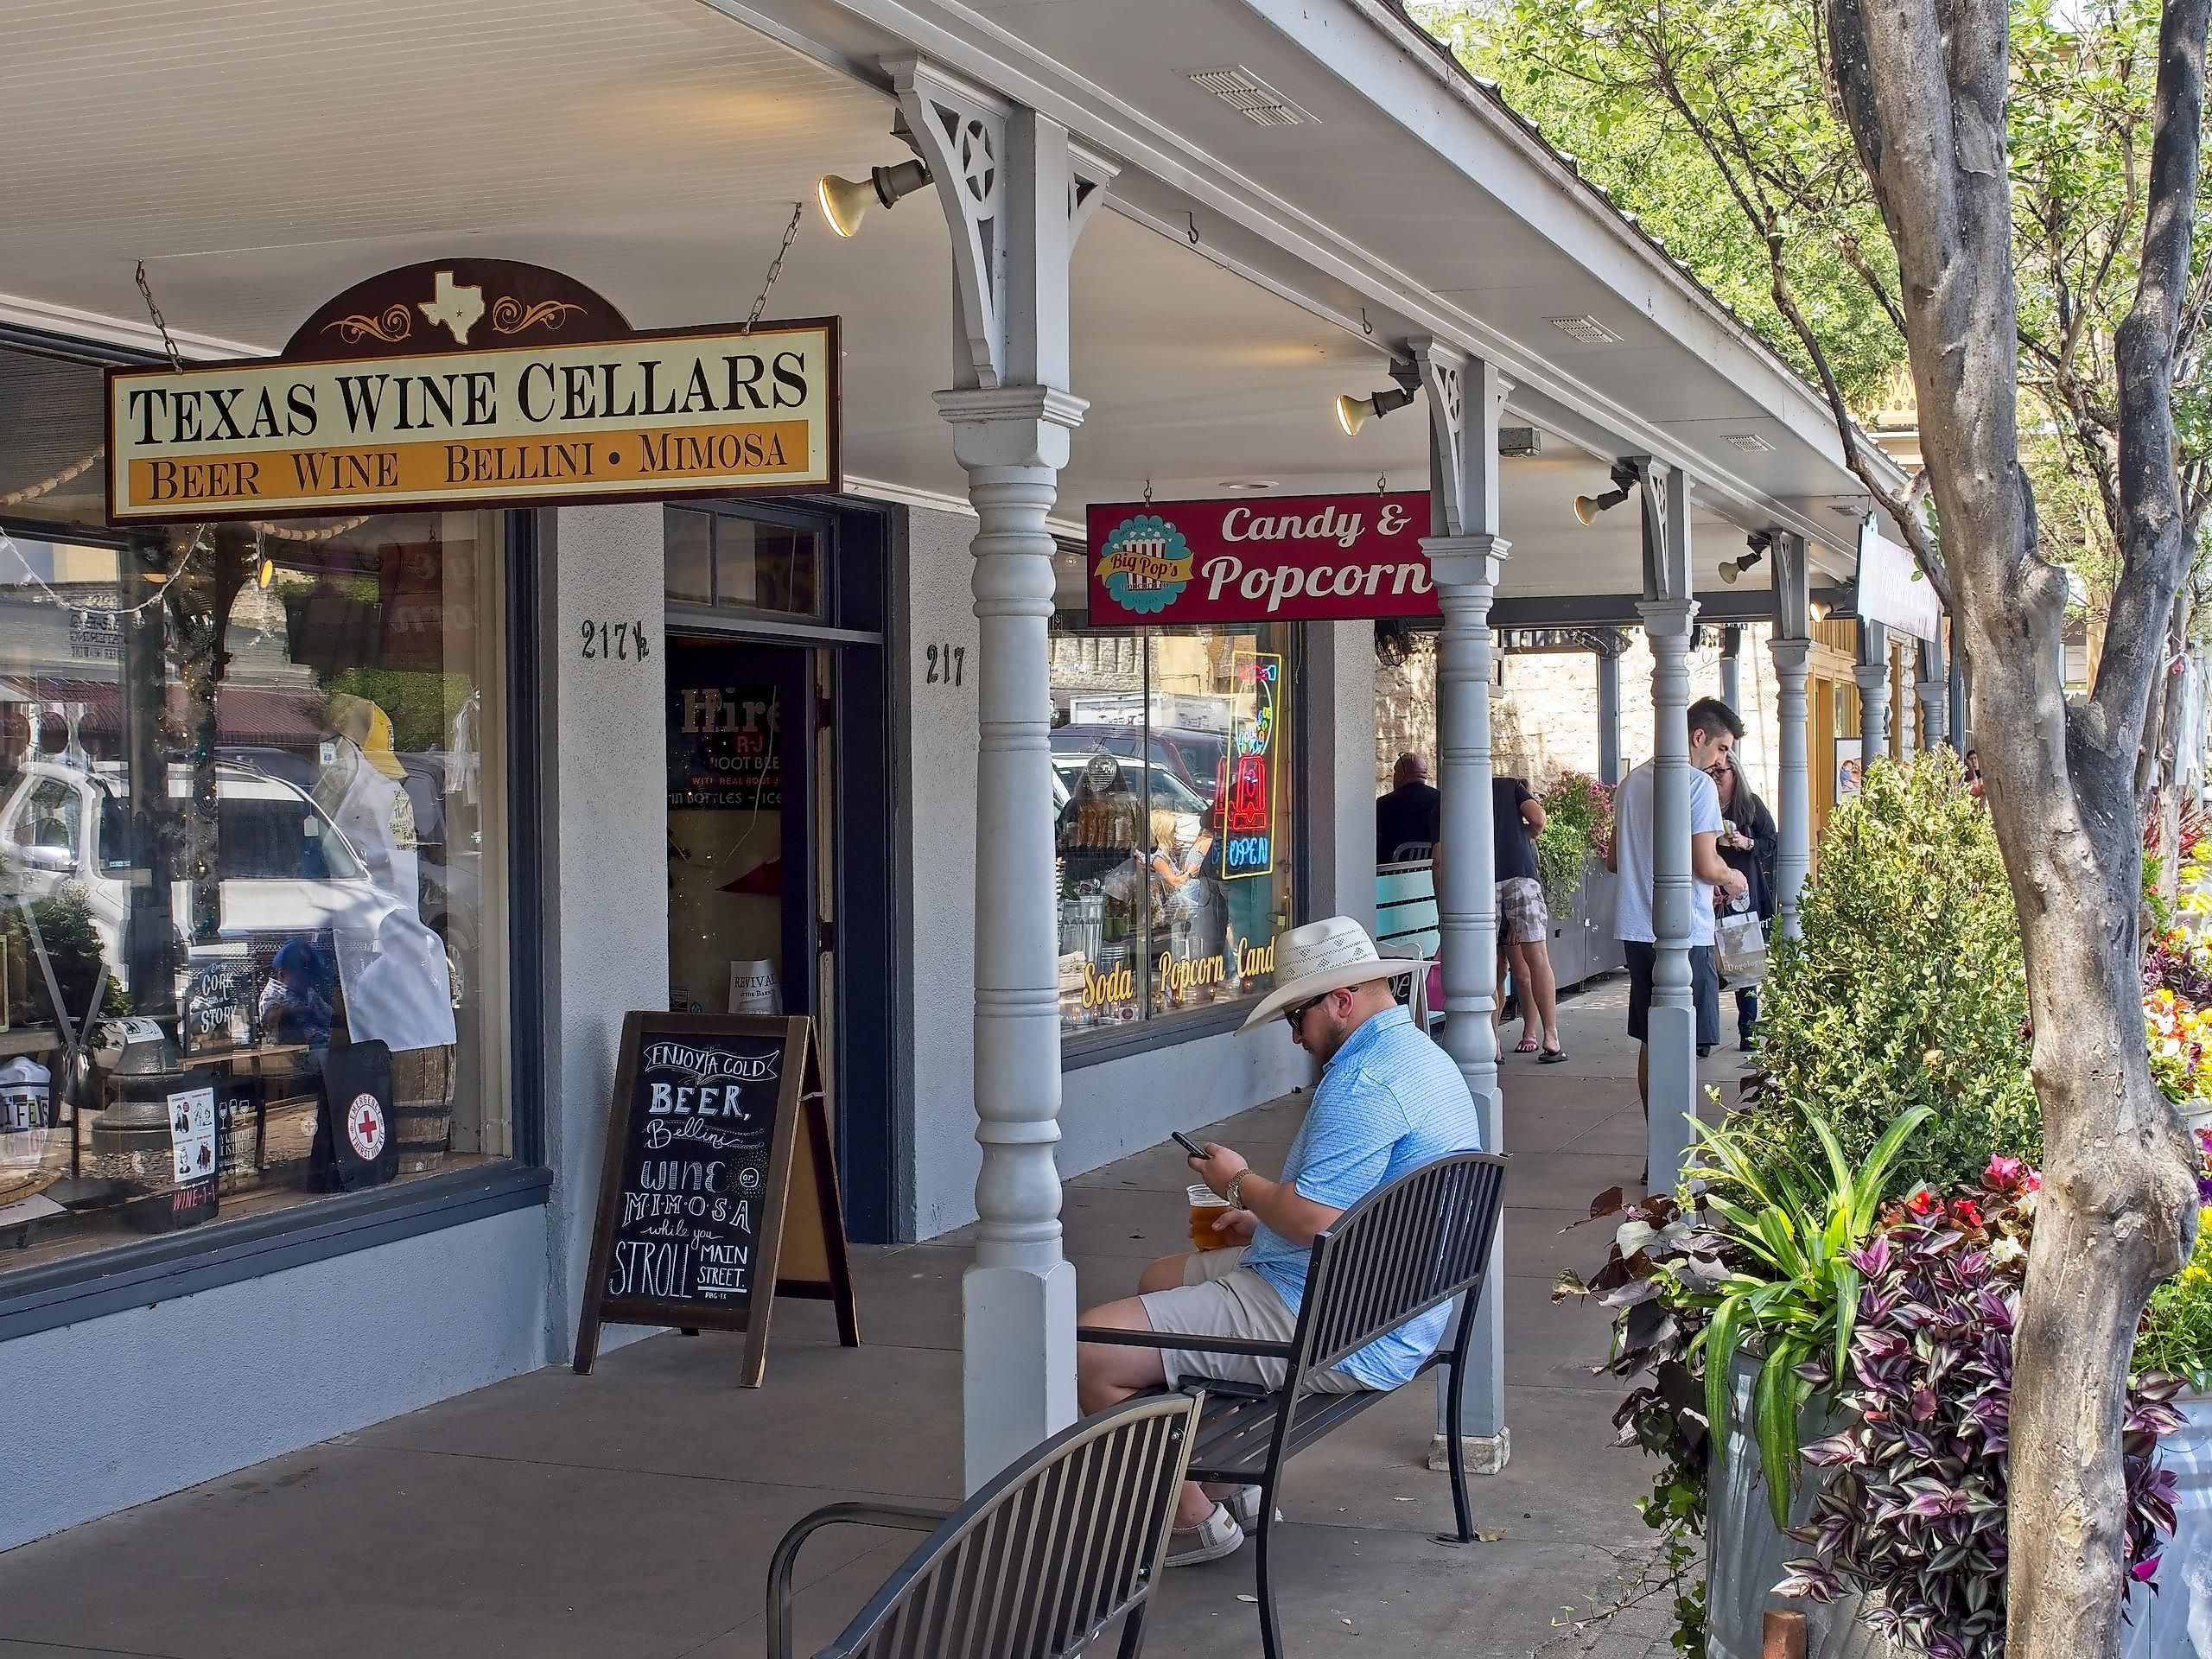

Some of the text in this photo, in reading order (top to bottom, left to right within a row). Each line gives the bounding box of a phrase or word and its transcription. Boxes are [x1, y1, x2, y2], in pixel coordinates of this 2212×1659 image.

[129, 351, 810, 446] TEXAS WINE CELLARS
[149, 430, 788, 501] BEER WINE BELLINI MIMOSA
[1221, 504, 1412, 548] Candy &
[1110, 553, 1179, 579] Big Pop's
[1201, 555, 1433, 612] Popcorn
[926, 643, 965, 687] 217
[736, 735, 764, 753] R-J
[1229, 836, 1268, 866] OPEN
[202, 973, 234, 1001] CORK
[1081, 960, 1134, 1009] Soda
[1159, 950, 1225, 1001] Popcorn
[200, 1004, 238, 1033] STORY
[652, 1046, 766, 1077] ENJOY A COLD
[350, 1096, 381, 1120] EMERGENCY
[648, 1082, 752, 1121] BEER,
[352, 1136, 370, 1158] THIRST
[742, 1173, 754, 1182] or
[640, 1218, 724, 1250] while you
[609, 1241, 692, 1299] STROLL
[700, 1244, 747, 1265] MAIN
